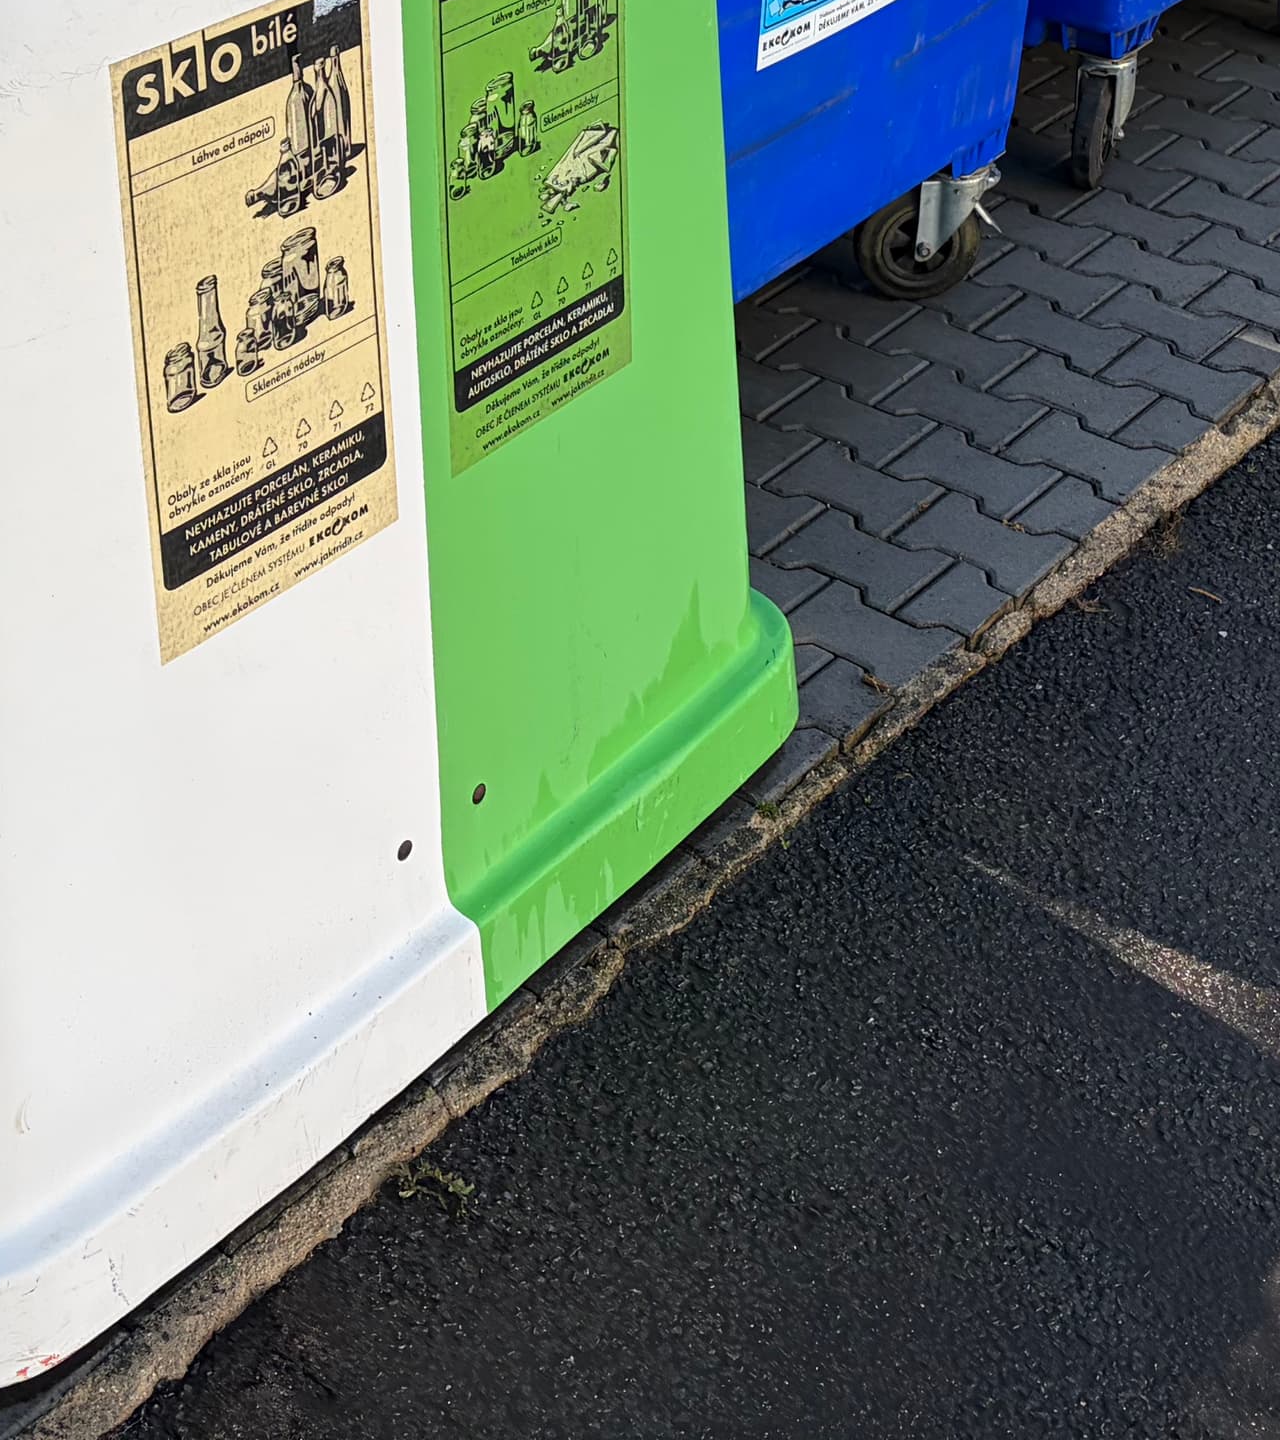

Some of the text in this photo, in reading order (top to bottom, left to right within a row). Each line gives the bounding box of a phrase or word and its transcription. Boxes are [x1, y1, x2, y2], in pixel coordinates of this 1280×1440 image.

[492, 10, 513, 26] Láhve
[514, 4, 525, 17] od
[136, 13, 297, 115] sklo bílé
[574, 93, 599, 114] nádoby
[192, 122, 271, 166] Láhve od nápojů
[510, 234, 558, 266] Tabulové sklo
[460, 328, 482, 348] Obaly
[482, 324, 492, 334] ze
[468, 303, 614, 400] AUTOSKLO, DRÁTĚNÉ SKLO A ZRCADLA!
[471, 292, 608, 380] NEVHAZUJTE PORCELÁN, KERAMIKU,
[252, 350, 326, 394] Skleněné nádoby
[486, 388, 520, 414] Děkujeme
[266, 402, 374, 470] GL 70 71 72
[476, 421, 495, 438] OBEC
[496, 415, 503, 426] JE
[504, 398, 531, 421] ČLENEM
[532, 380, 560, 403] SYSTÉMU
[482, 411, 540, 450] www.ekokom.cz
[168, 456, 251, 506] Obaly ze skla jsou
[169, 468, 254, 520] obvykle označeny:
[185, 430, 365, 540] NEVHAZUJTE PORCELÁN, KERAMIKU,
[188, 450, 364, 557] KAMENY, DRÁTĚNÉ SKLO, ZRCADLA,
[206, 492, 356, 588] Děkujeme Vám, že třídíte odpady!
[209, 474, 349, 562] TABULOVÉ A BAREVNÉ SKLO!
[194, 594, 220, 617] OBEC
[220, 590, 230, 603] JE
[230, 568, 266, 596] ČLENEM
[268, 544, 306, 572] SYSTÉMU
[203, 529, 364, 634] www.ekokom.cz www.jaktridit.cz
